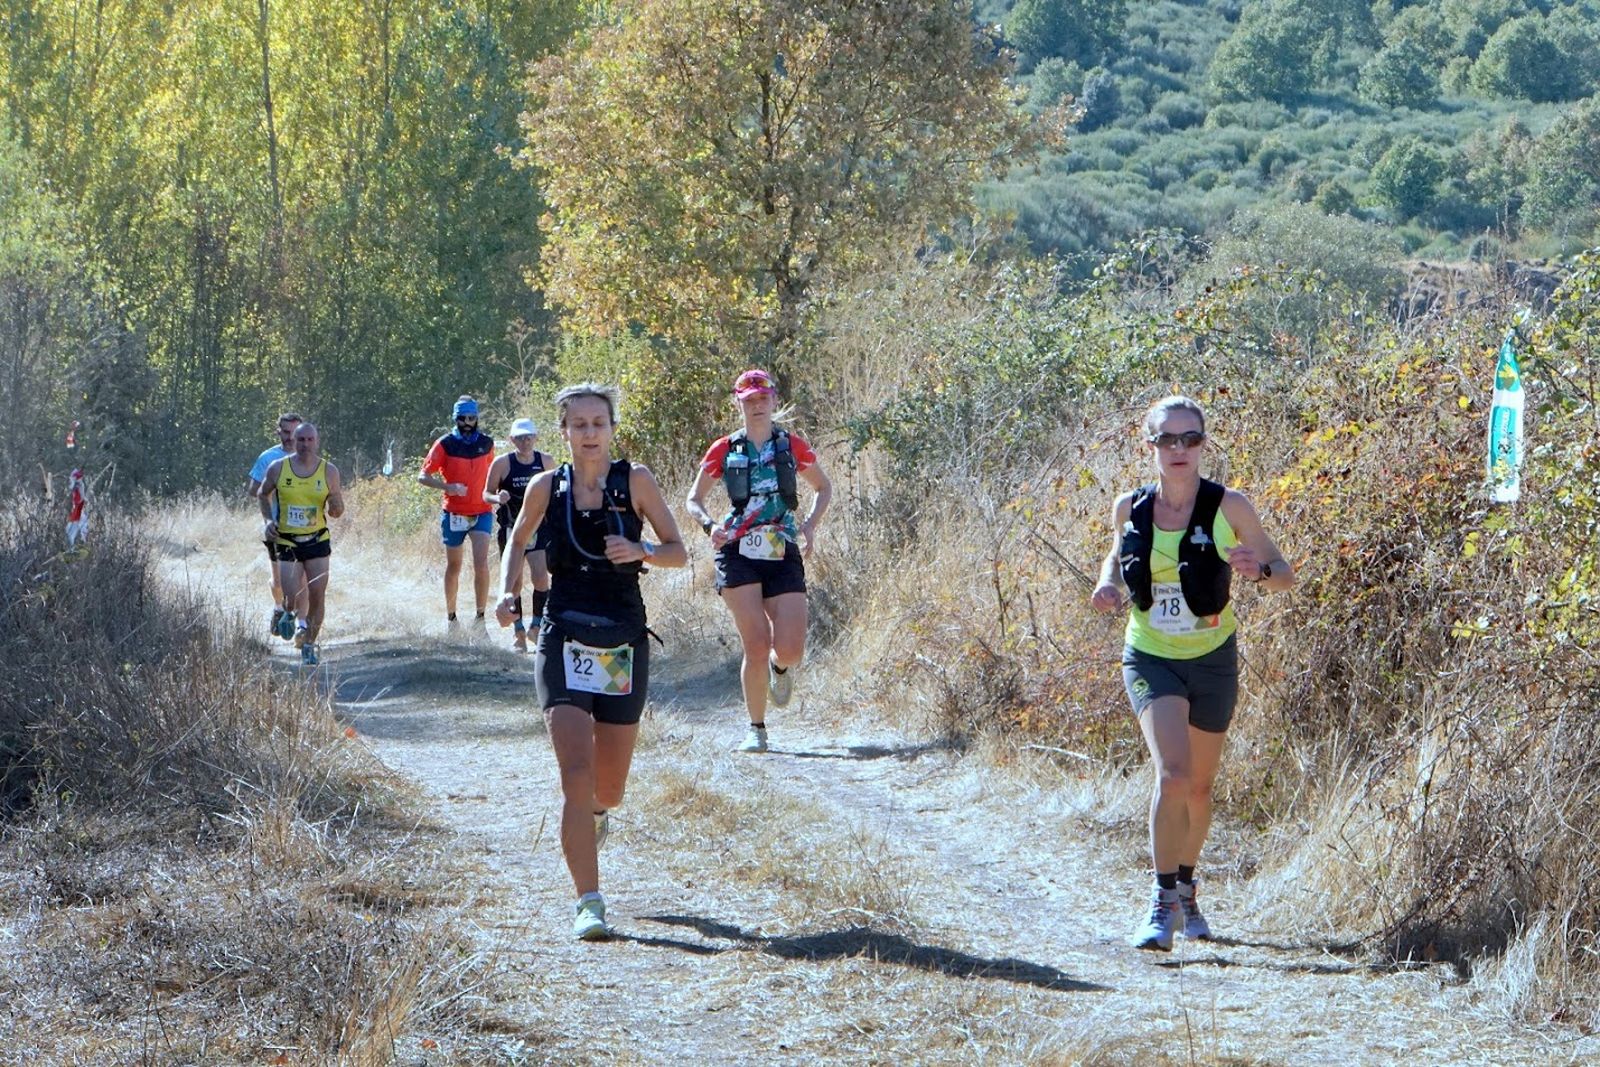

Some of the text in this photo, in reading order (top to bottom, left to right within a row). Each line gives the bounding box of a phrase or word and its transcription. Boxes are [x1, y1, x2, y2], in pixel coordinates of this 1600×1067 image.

[289, 511, 305, 520] 116
[746, 532, 762, 547] 30
[1160, 597, 1180, 616] 18
[573, 657, 593, 676] 22
